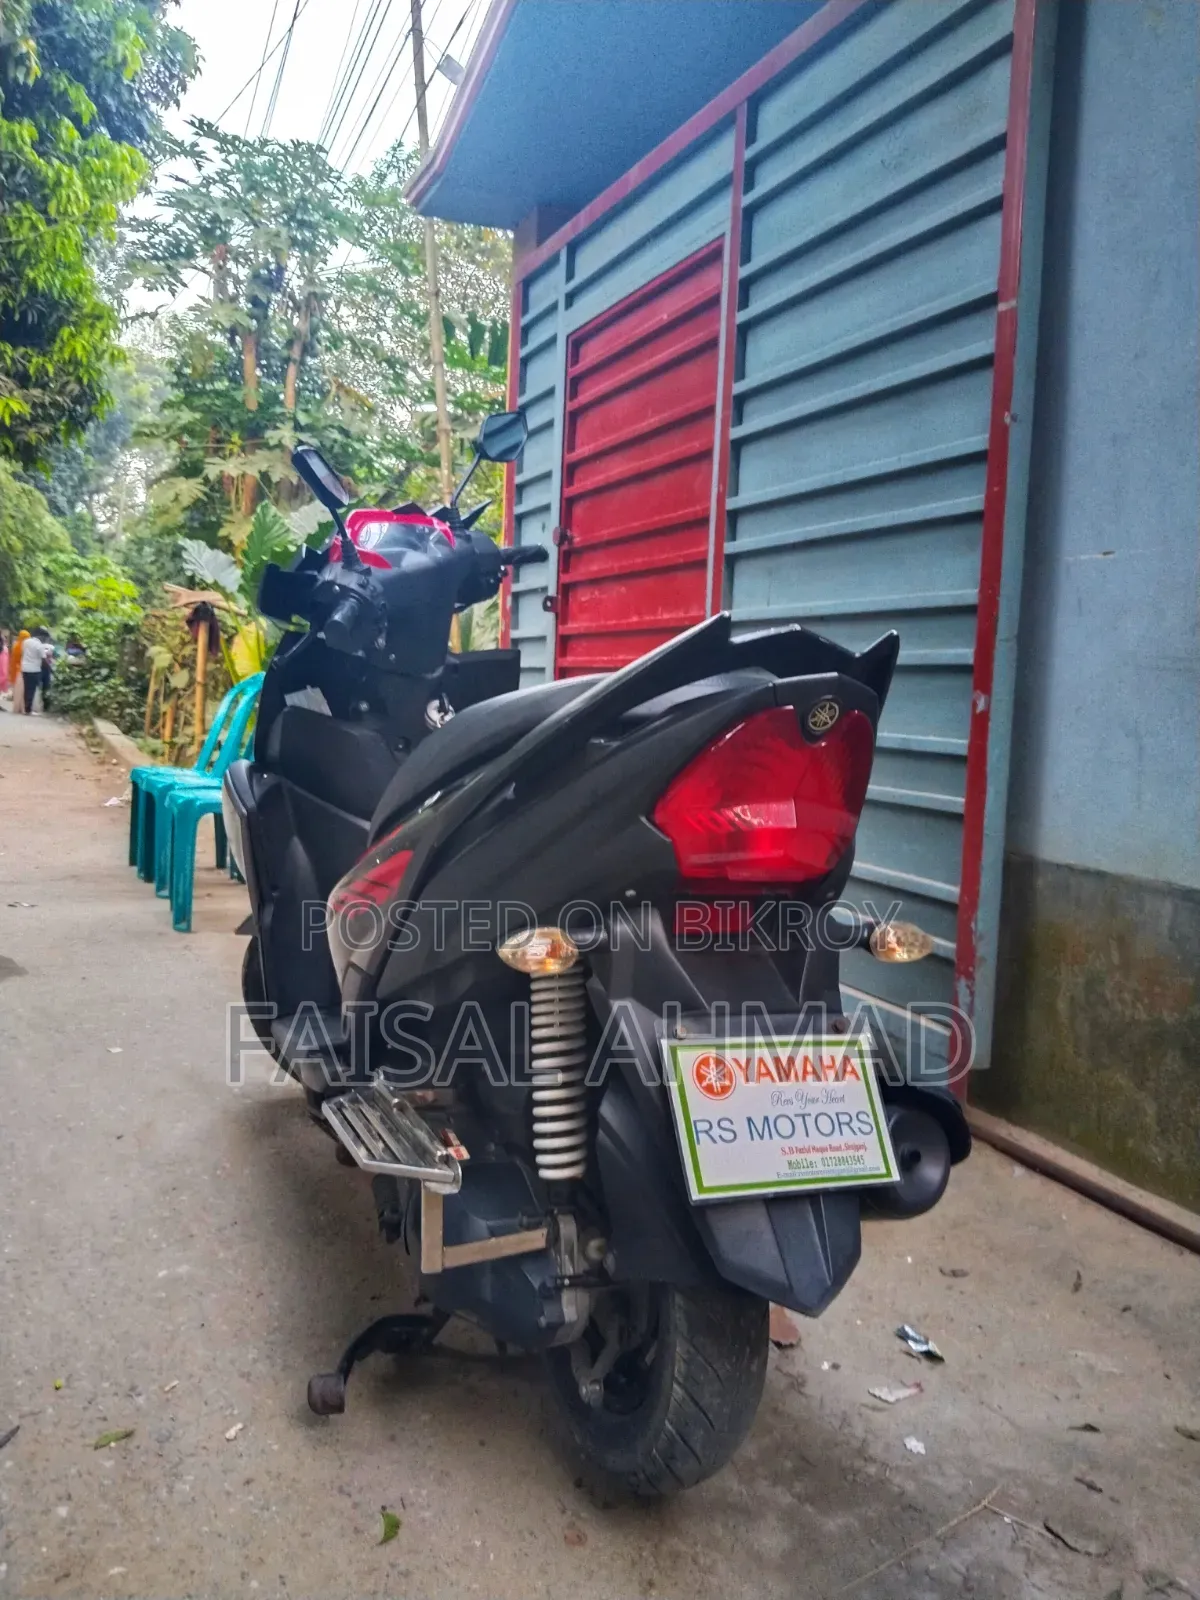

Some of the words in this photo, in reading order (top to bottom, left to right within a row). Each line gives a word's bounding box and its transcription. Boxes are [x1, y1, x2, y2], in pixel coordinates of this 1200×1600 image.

[732, 1055, 861, 1084] YAMAHA
[770, 1090, 794, 1106] Revs
[794, 1088, 819, 1109] Your
[821, 1088, 846, 1105] Heart
[693, 1117, 738, 1145] RS
[746, 1111, 874, 1141] MOTORS
[787, 1157, 817, 1170] Mobile:
